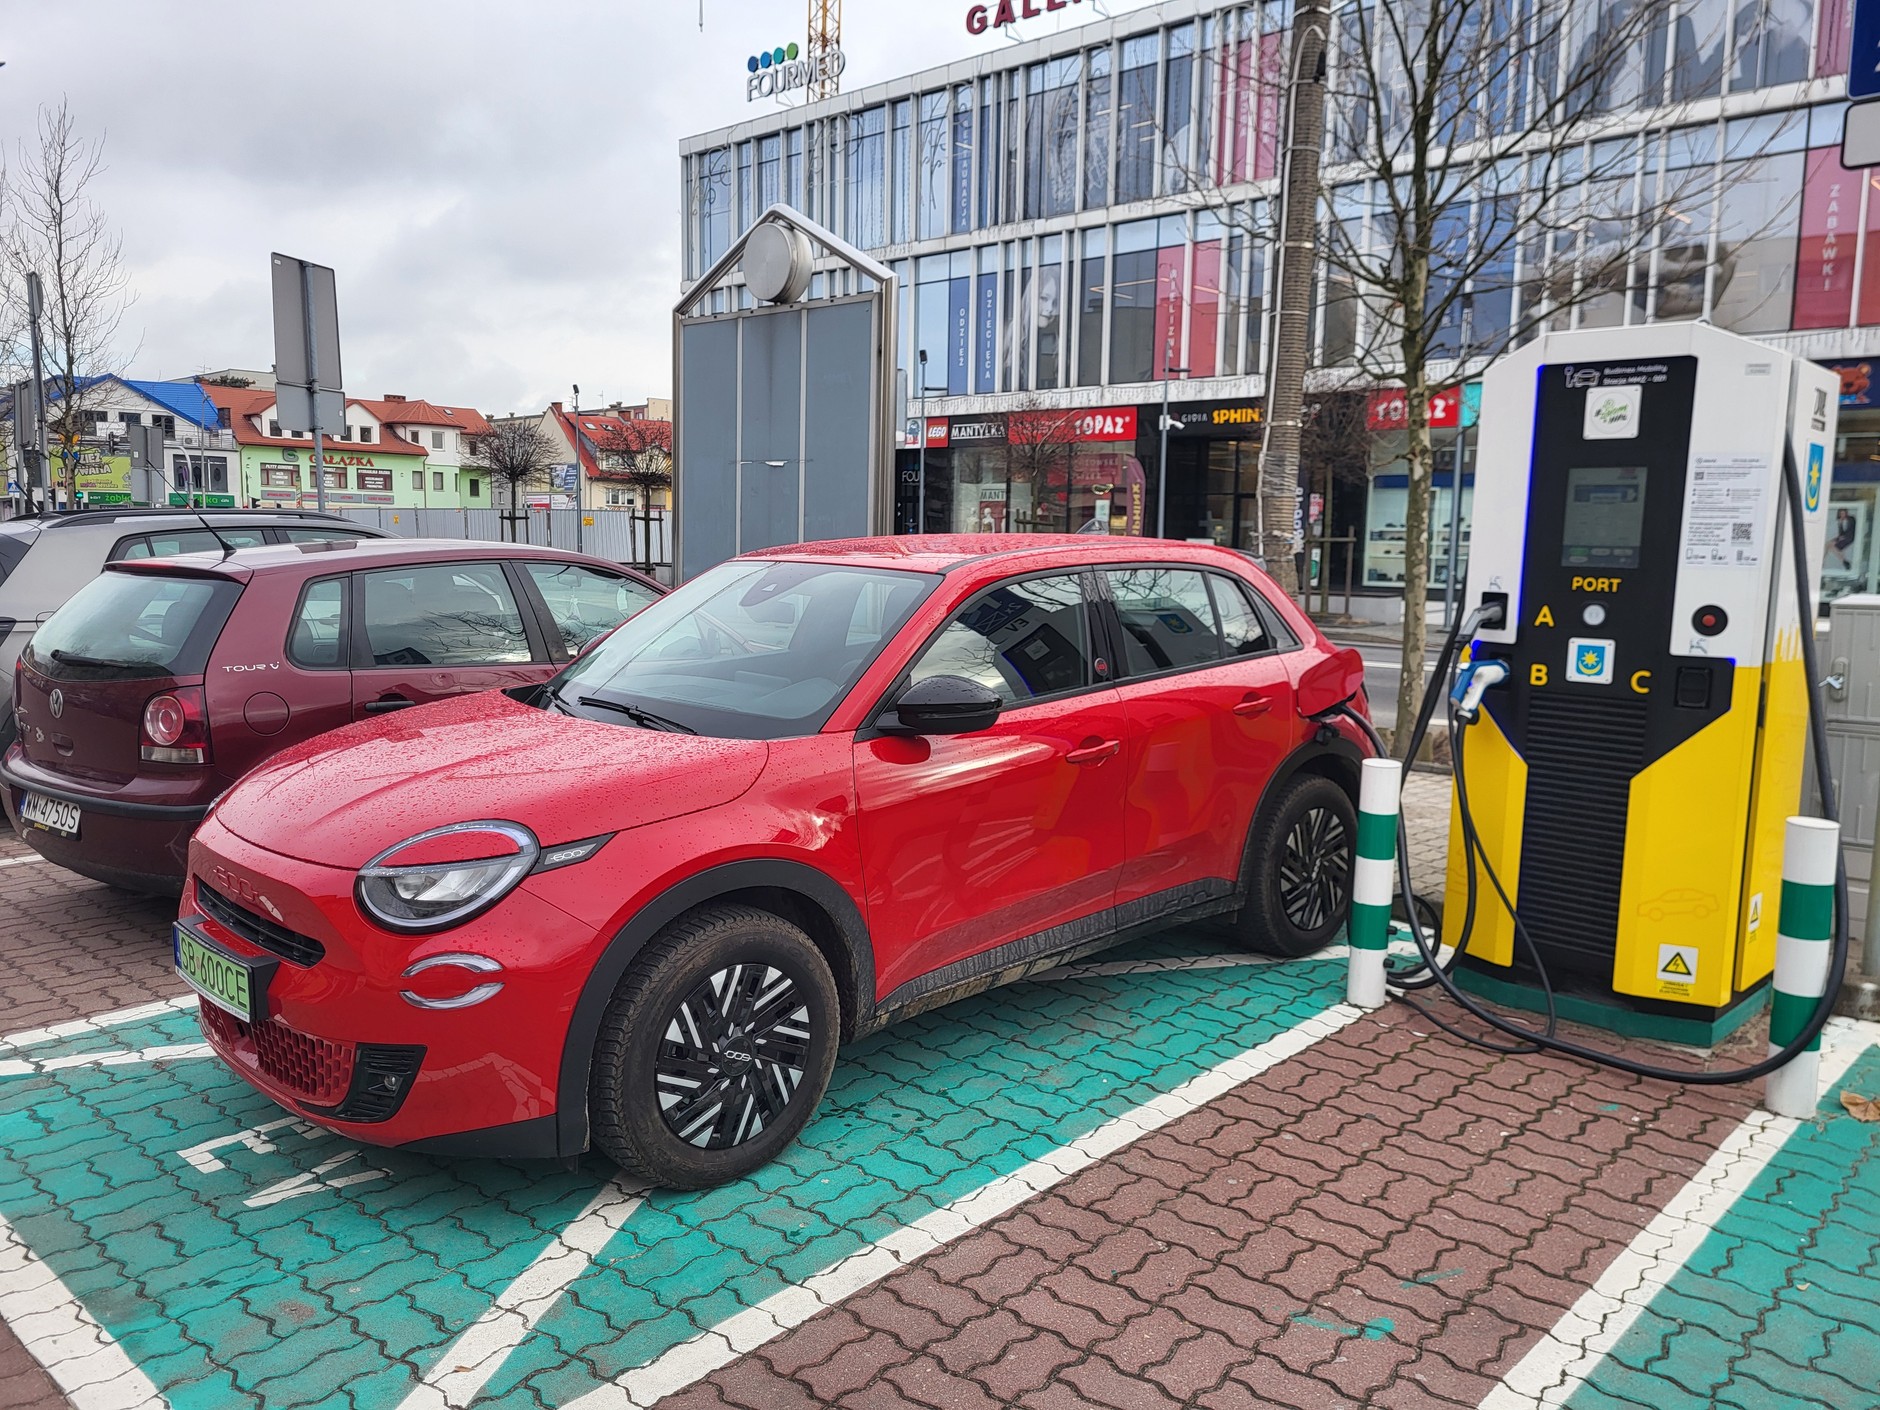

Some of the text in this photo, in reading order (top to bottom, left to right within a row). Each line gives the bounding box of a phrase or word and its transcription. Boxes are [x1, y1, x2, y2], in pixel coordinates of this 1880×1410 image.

[746, 50, 846, 103] FOURMED
[1822, 183, 1840, 292] ZABAWKI
[1167, 268, 1178, 358] BIELIZNA
[958, 308, 966, 367] ODZIEŻ
[984, 289, 993, 379] DZIECIĘCA
[1212, 408, 1264, 424] SPHIN
[927, 424, 947, 438] LEGO
[1571, 576, 1622, 593] PORT
[1534, 605, 1555, 628] A
[222, 664, 266, 672] TOUR
[1529, 663, 1549, 686] B
[1630, 670, 1652, 694] C
[25, 794, 79, 831] WM 4750S
[551, 849, 585, 862] 600
[181, 936, 248, 1008] SB 600CE
